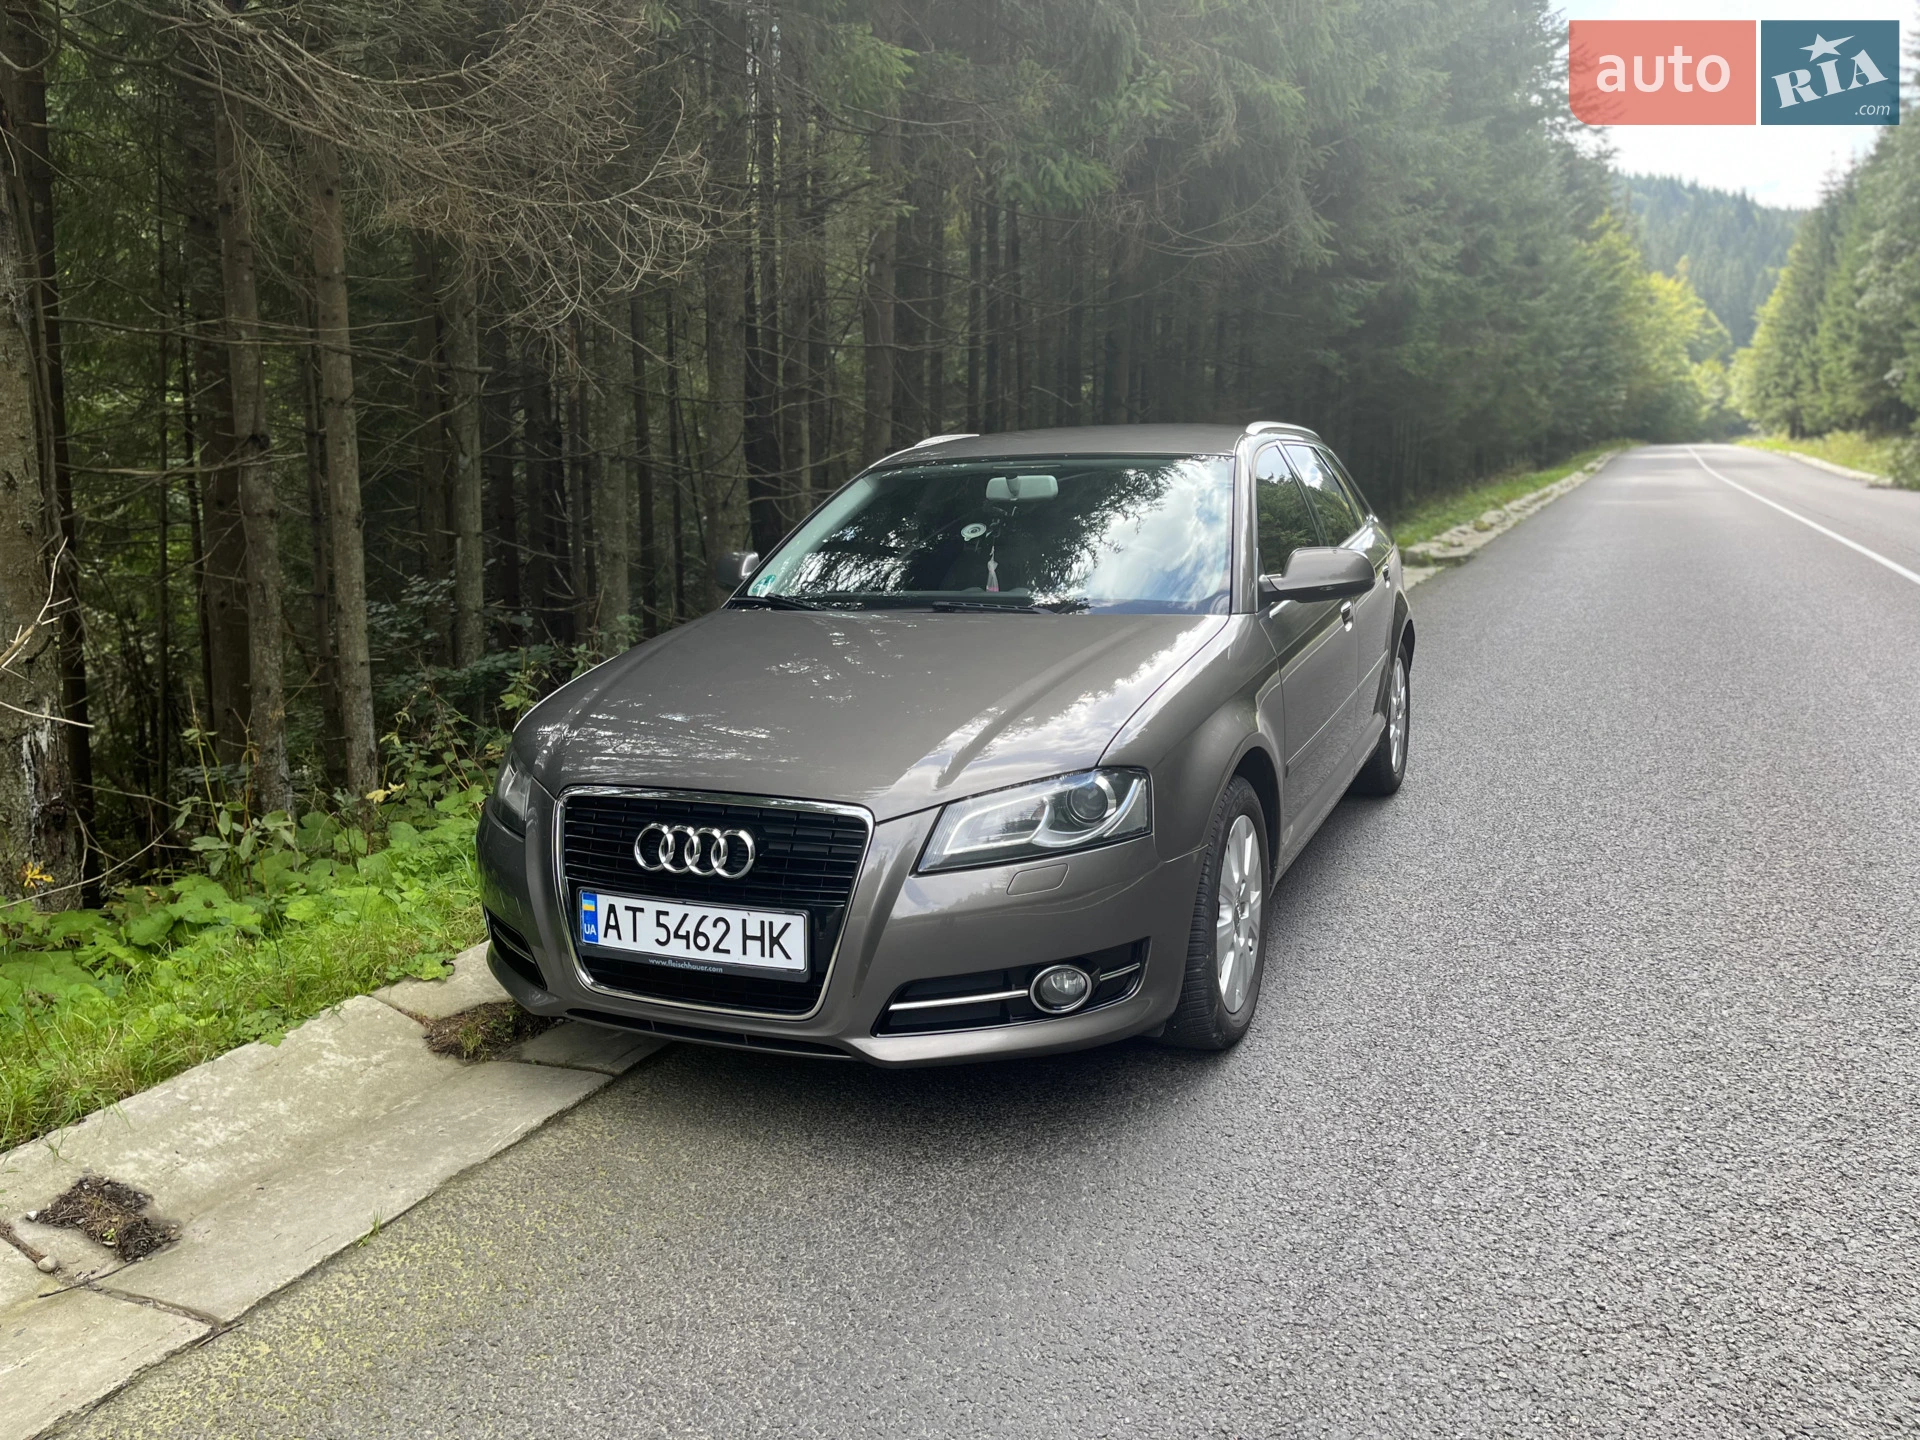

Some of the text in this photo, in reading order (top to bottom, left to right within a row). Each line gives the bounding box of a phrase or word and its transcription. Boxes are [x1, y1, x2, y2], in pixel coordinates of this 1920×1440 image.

[584, 923, 597, 936] UA
[603, 903, 792, 960] AT 5462 HK
[648, 958, 723, 973] www.fleischhauer.com
